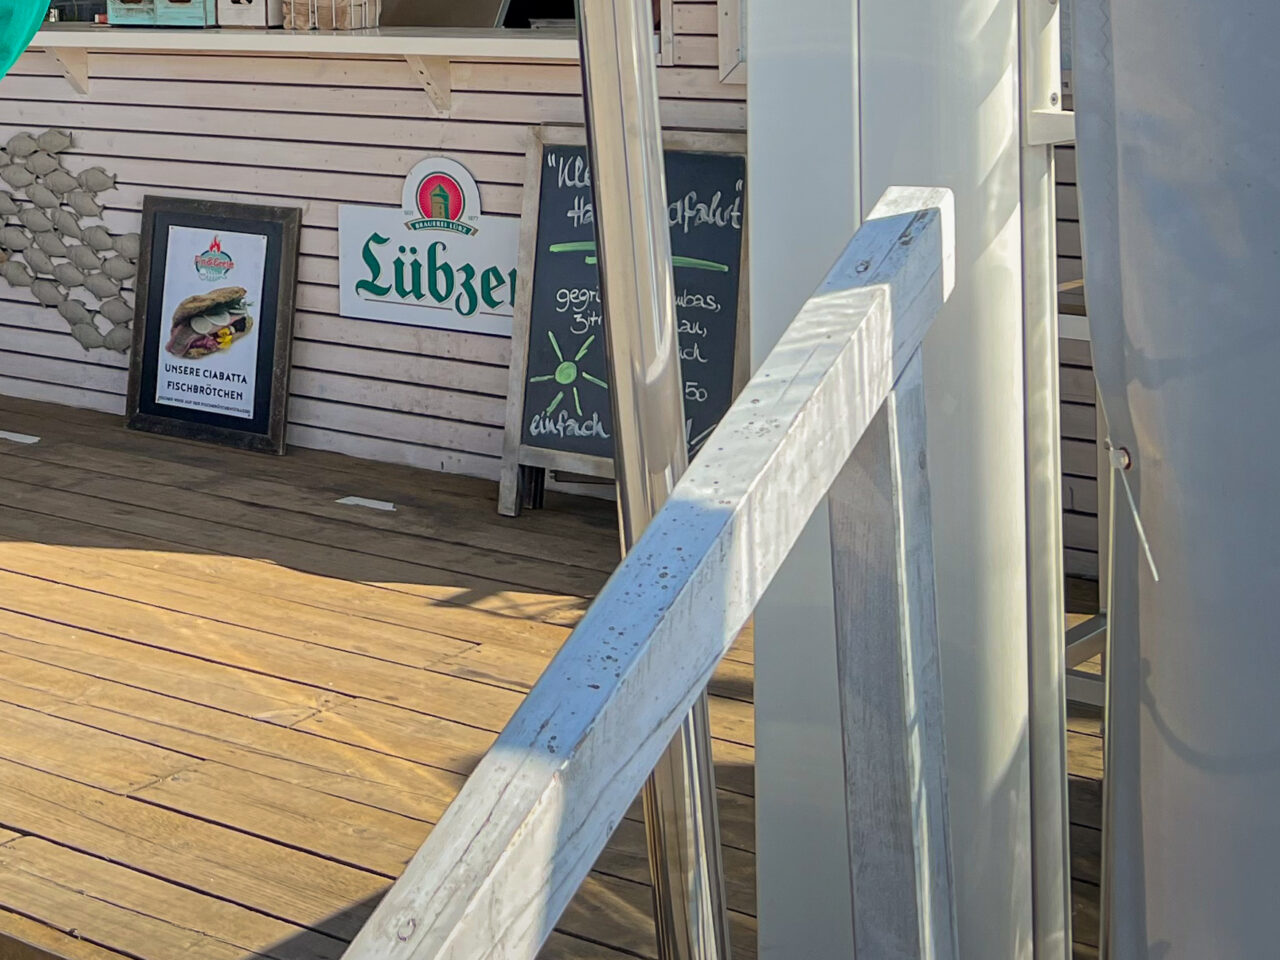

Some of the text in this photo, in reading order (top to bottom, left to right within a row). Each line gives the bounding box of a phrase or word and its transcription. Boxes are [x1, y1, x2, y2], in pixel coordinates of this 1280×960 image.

[556, 285, 601, 312] gegri
[165, 363, 248, 385] UNSERE CIABATTA
[167, 380, 244, 400] FISCHBRÖTCHEN
[530, 410, 611, 438] einfach
